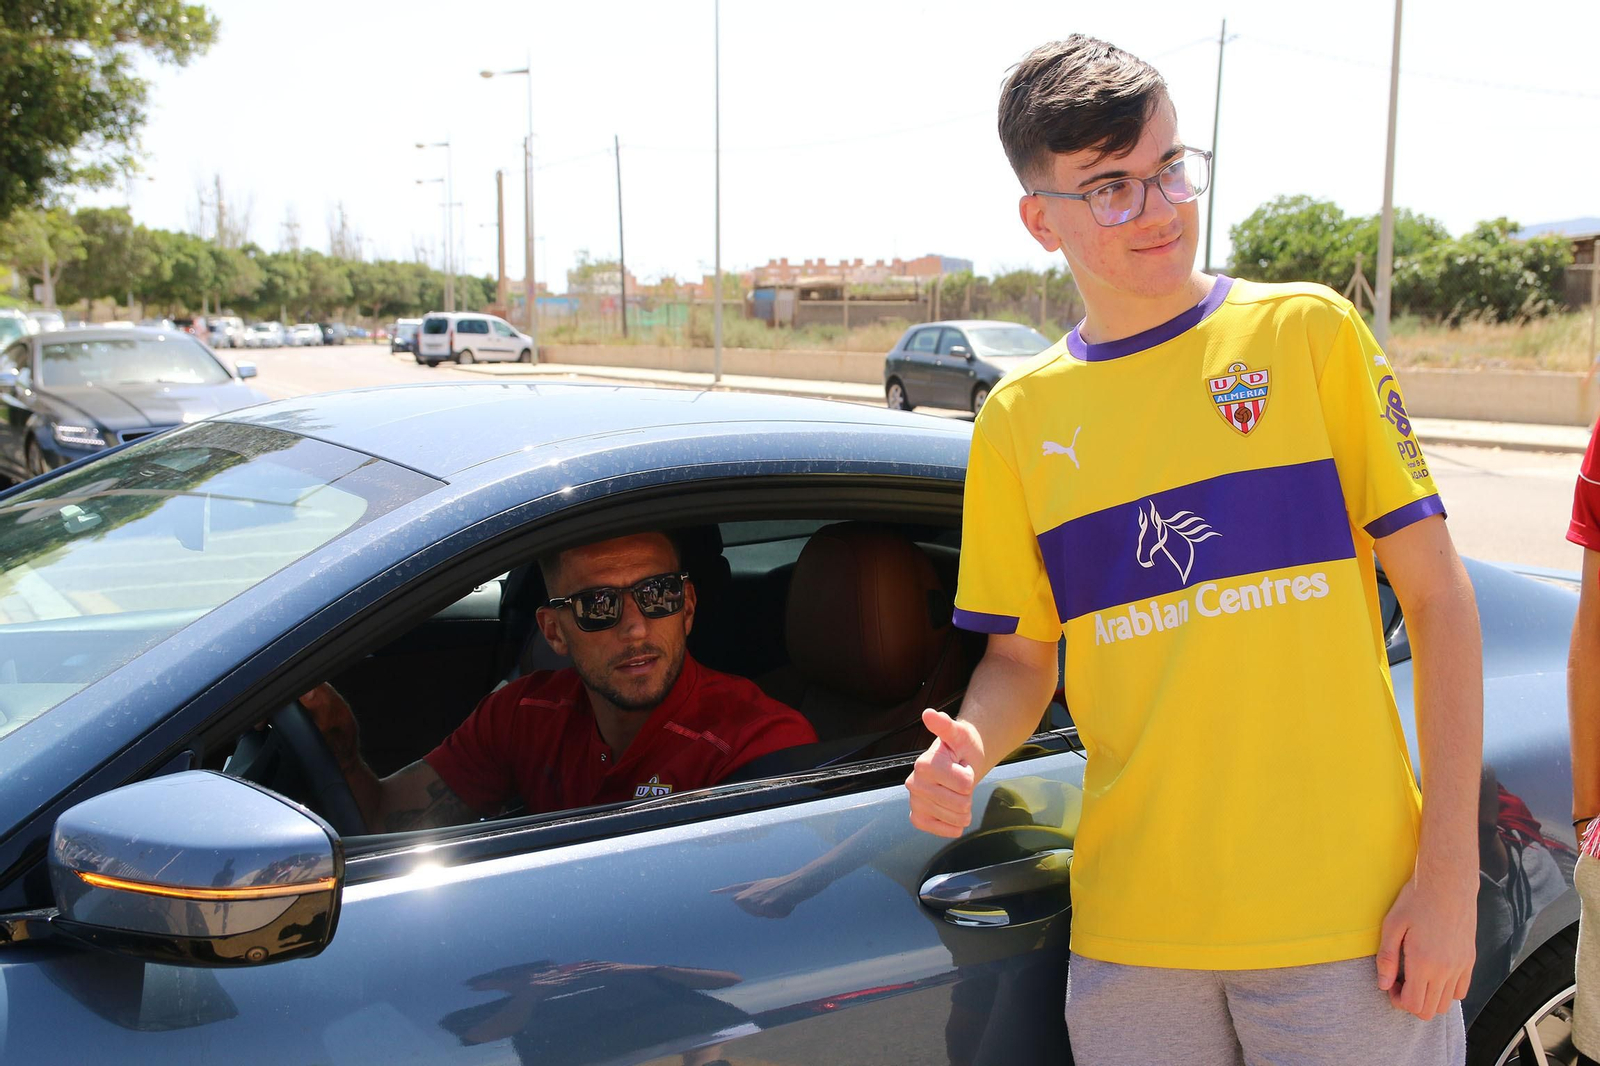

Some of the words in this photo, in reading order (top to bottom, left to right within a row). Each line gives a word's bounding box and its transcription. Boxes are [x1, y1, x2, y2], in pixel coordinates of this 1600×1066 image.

[1214, 379, 1227, 389] U
[1249, 373, 1263, 383] D
[1216, 388, 1265, 403] ALMERIA
[1095, 599, 1189, 645] Arabian
[1195, 573, 1329, 617] Centres
[638, 787, 646, 795] U
